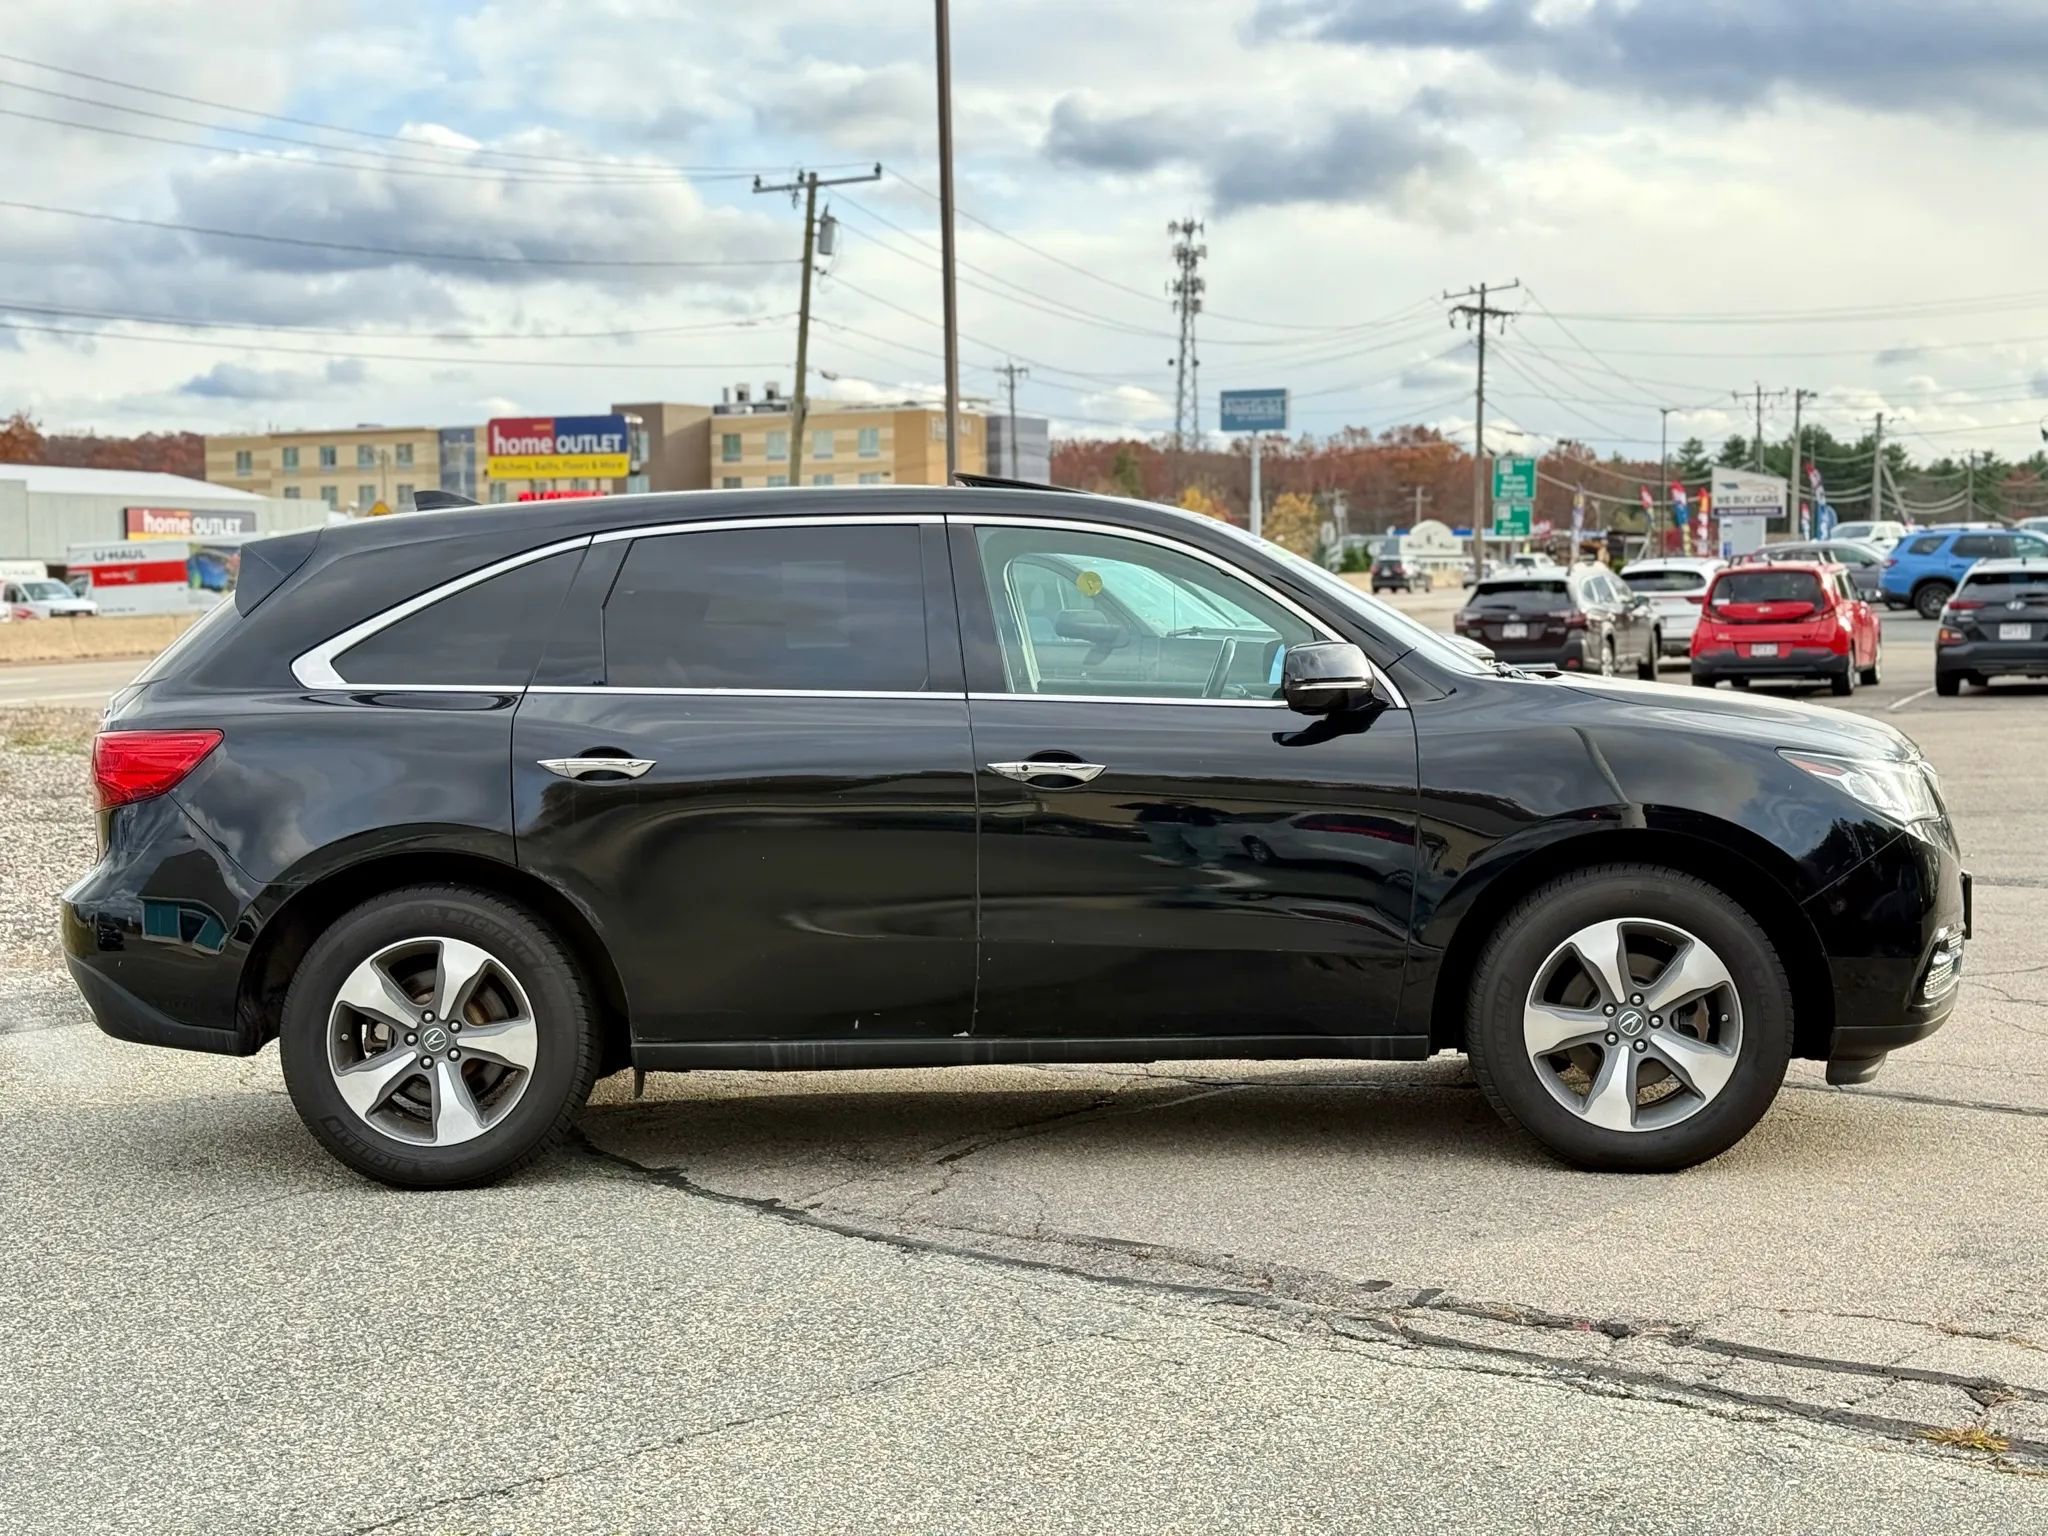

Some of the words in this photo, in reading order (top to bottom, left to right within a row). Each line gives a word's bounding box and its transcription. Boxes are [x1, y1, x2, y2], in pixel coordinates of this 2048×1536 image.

[493, 425, 553, 455] home
[556, 433, 623, 454] OUTLET
[1717, 496, 1731, 504] WE
[1734, 496, 1752, 504] BUY
[1754, 495, 1779, 504] CARS
[143, 509, 191, 534] home
[192, 516, 242, 535] OUTLET
[93, 549, 146, 562] U-HAUL
